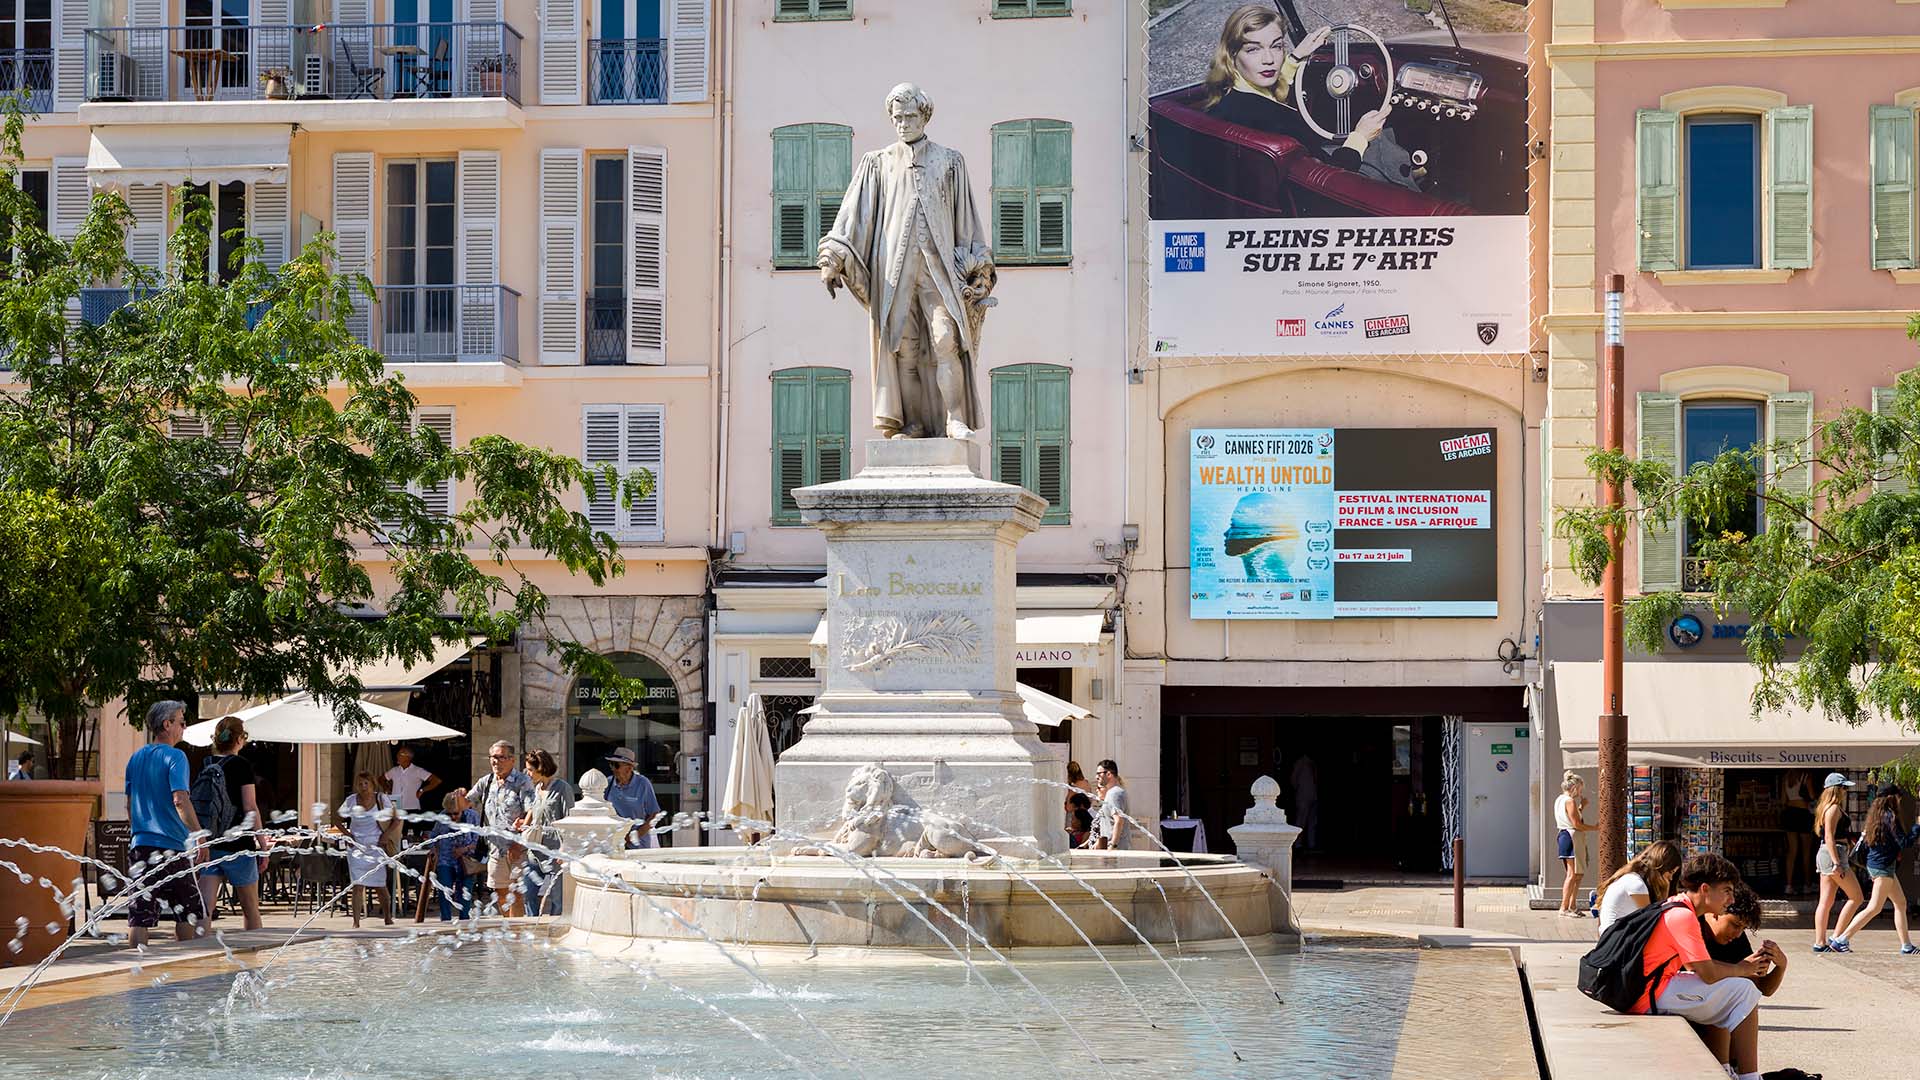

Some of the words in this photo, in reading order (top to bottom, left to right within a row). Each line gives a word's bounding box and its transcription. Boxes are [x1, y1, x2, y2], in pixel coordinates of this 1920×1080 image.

[1171, 234, 1198, 246] CANNES
[1225, 229, 1329, 248] PLEINS
[1335, 228, 1455, 247] PHARES
[1165, 246, 1180, 258] FAIT
[1180, 246, 1188, 258] LE
[1188, 246, 1204, 258] MUR
[1177, 259, 1193, 270] 2026
[1243, 253, 1301, 272] SUR
[1308, 252, 1345, 271] LE
[1297, 280, 1325, 288] Simone
[1327, 280, 1361, 289] Signoret,
[1276, 320, 1305, 336] MATCH
[1314, 320, 1354, 329] CANNES
[1367, 329, 1379, 338] LES
[1380, 327, 1409, 336] ARCADES
[1225, 440, 1264, 455] CANNES
[1267, 440, 1285, 454] FIFI
[1288, 440, 1313, 454] 2026
[1444, 452, 1457, 461] LES
[1458, 446, 1491, 458] ARCADES
[1200, 466, 1265, 485] WEALTH
[1271, 465, 1332, 485] UNTOLD
[1339, 495, 1393, 503] FESTIVAL
[1395, 494, 1488, 503] INTERNATIONAL
[1339, 506, 1355, 515] DU
[1357, 506, 1385, 515] FILM
[1387, 506, 1395, 515] &
[1397, 506, 1459, 515] INCLUSION
[1339, 518, 1384, 526] FRANCE
[1395, 518, 1417, 526] USA
[1429, 517, 1478, 528] AFRIQUE
[1388, 552, 1404, 561] juin
[1015, 650, 1072, 661] ALIANO
[575, 687, 590, 699] LES
[592, 687, 621, 699] ALES
[1710, 751, 1762, 763] Biscuits
[1779, 750, 1847, 763] Souvenirs
